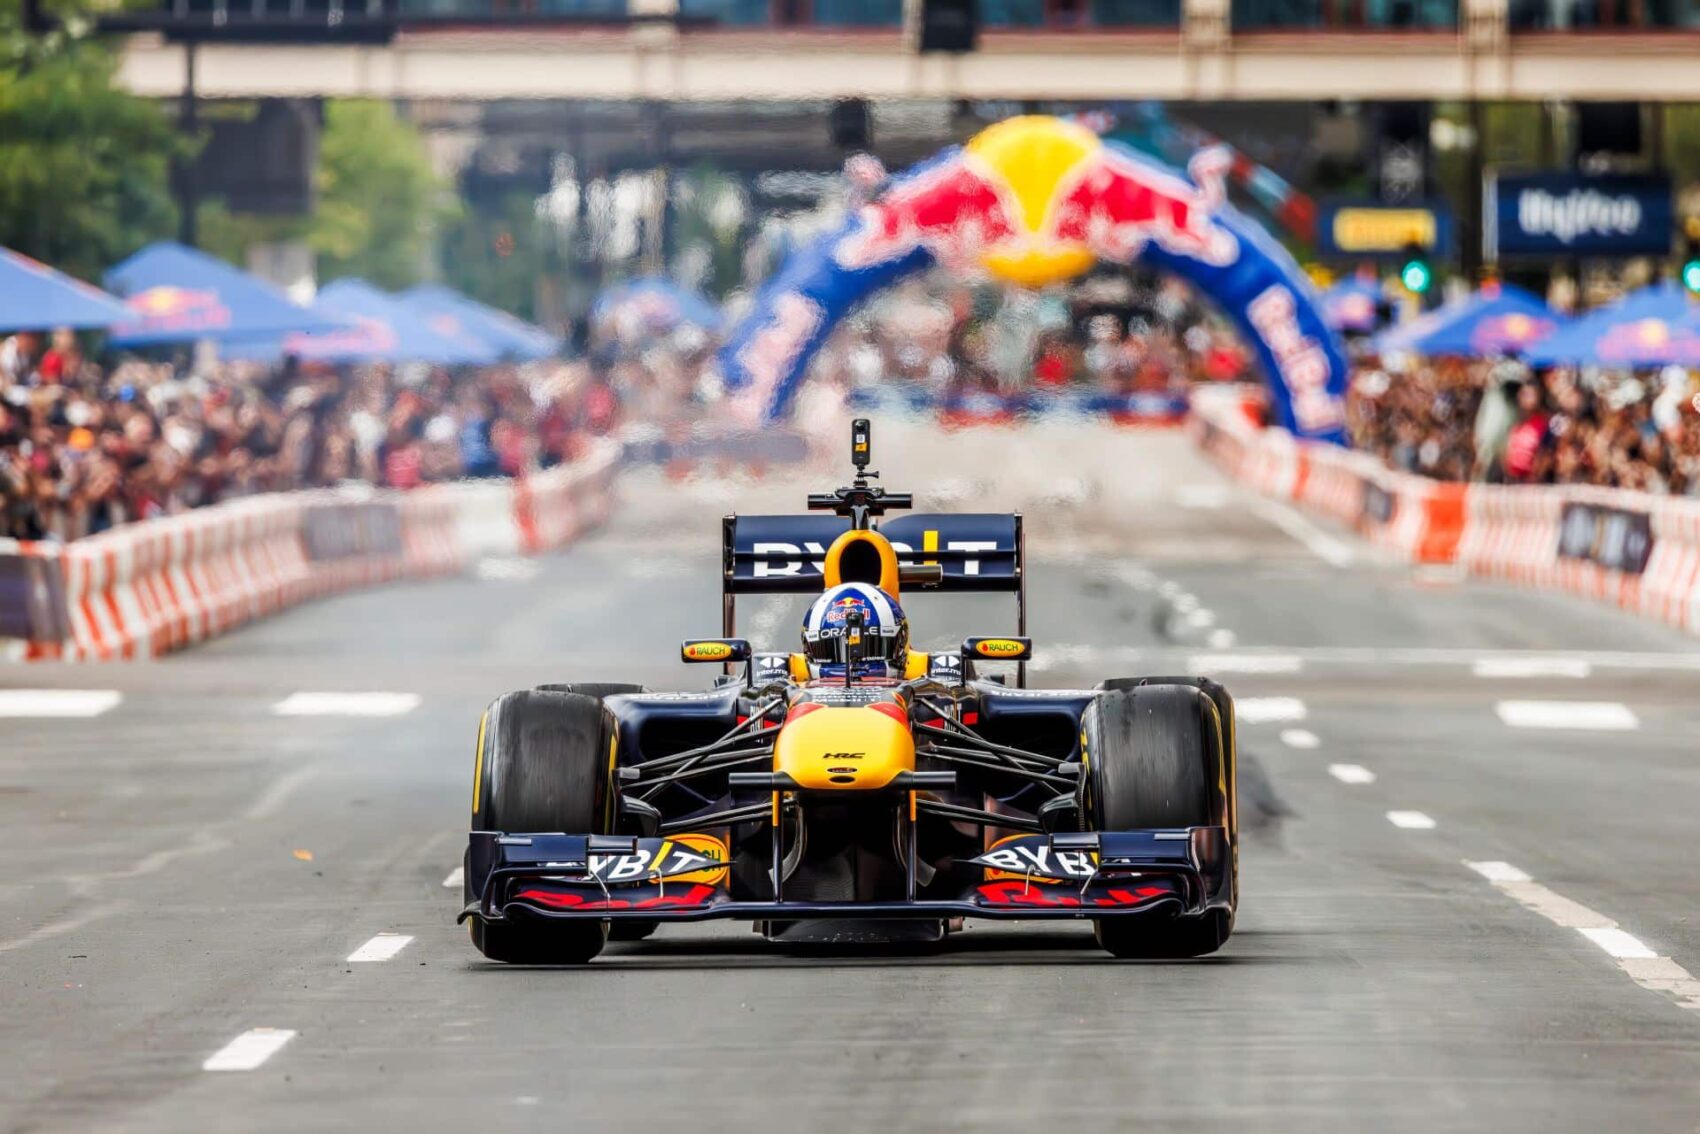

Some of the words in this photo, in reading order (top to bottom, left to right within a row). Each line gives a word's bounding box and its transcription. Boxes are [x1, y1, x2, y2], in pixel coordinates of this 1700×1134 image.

[753, 530, 997, 577] BIT
[820, 626, 879, 639] ORAE
[696, 646, 726, 656] RAUCH
[988, 643, 1019, 652] RAUCH
[548, 841, 707, 881] YBIT
[982, 845, 1108, 876] BYB
